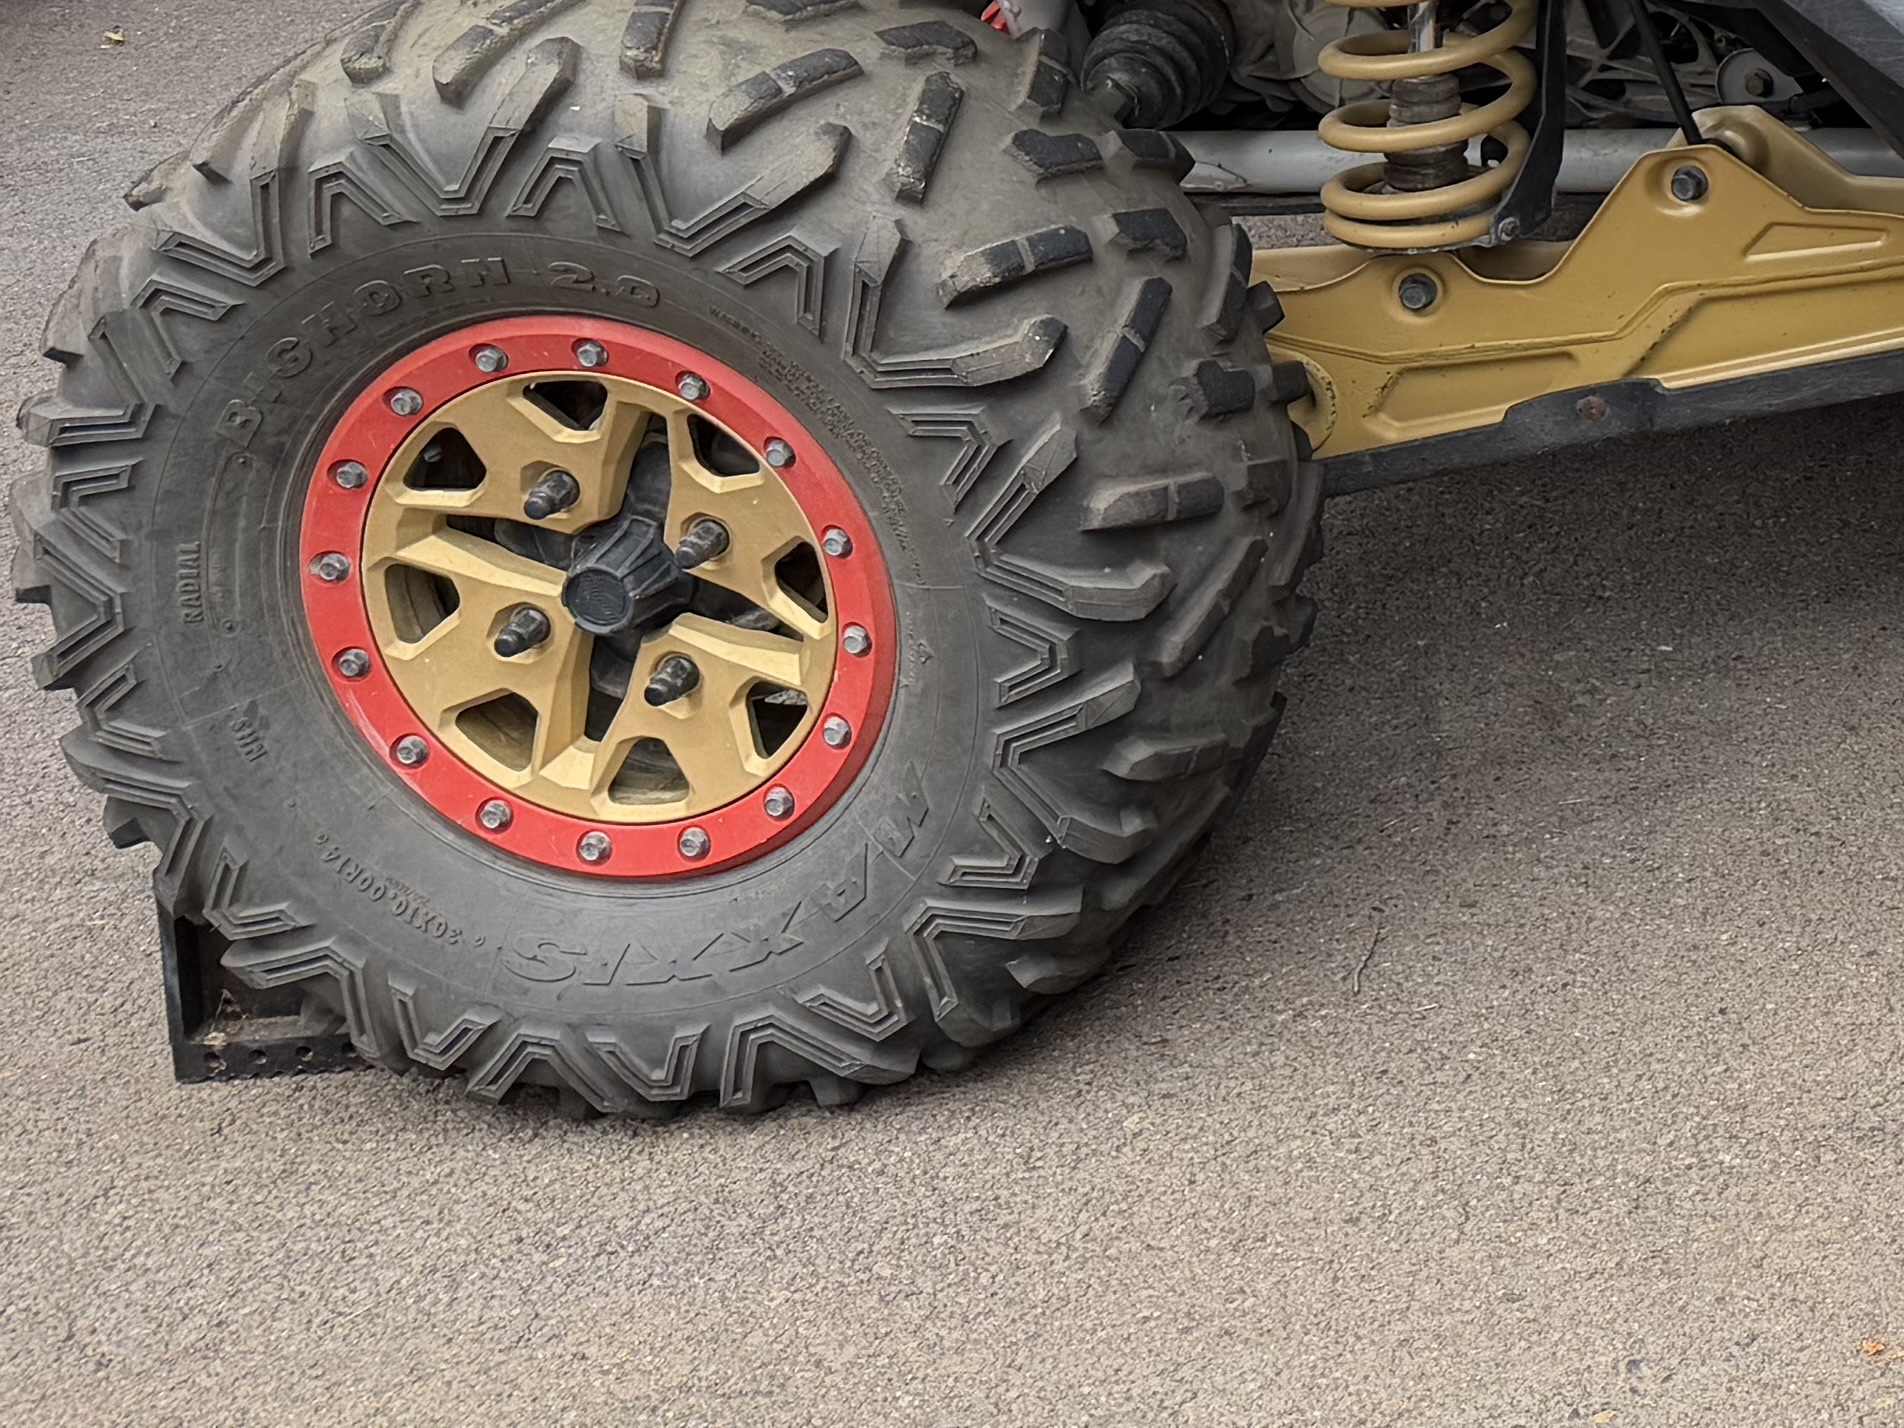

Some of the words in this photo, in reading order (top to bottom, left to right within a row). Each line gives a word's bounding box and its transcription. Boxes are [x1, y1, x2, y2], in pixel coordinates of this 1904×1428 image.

[212, 256, 511, 448] BIGHORN
[546, 259, 661, 309] 2.0
[174, 540, 205, 625] RADIAL
[229, 716, 268, 763] NHS
[500, 756, 932, 988] MAXXIS
